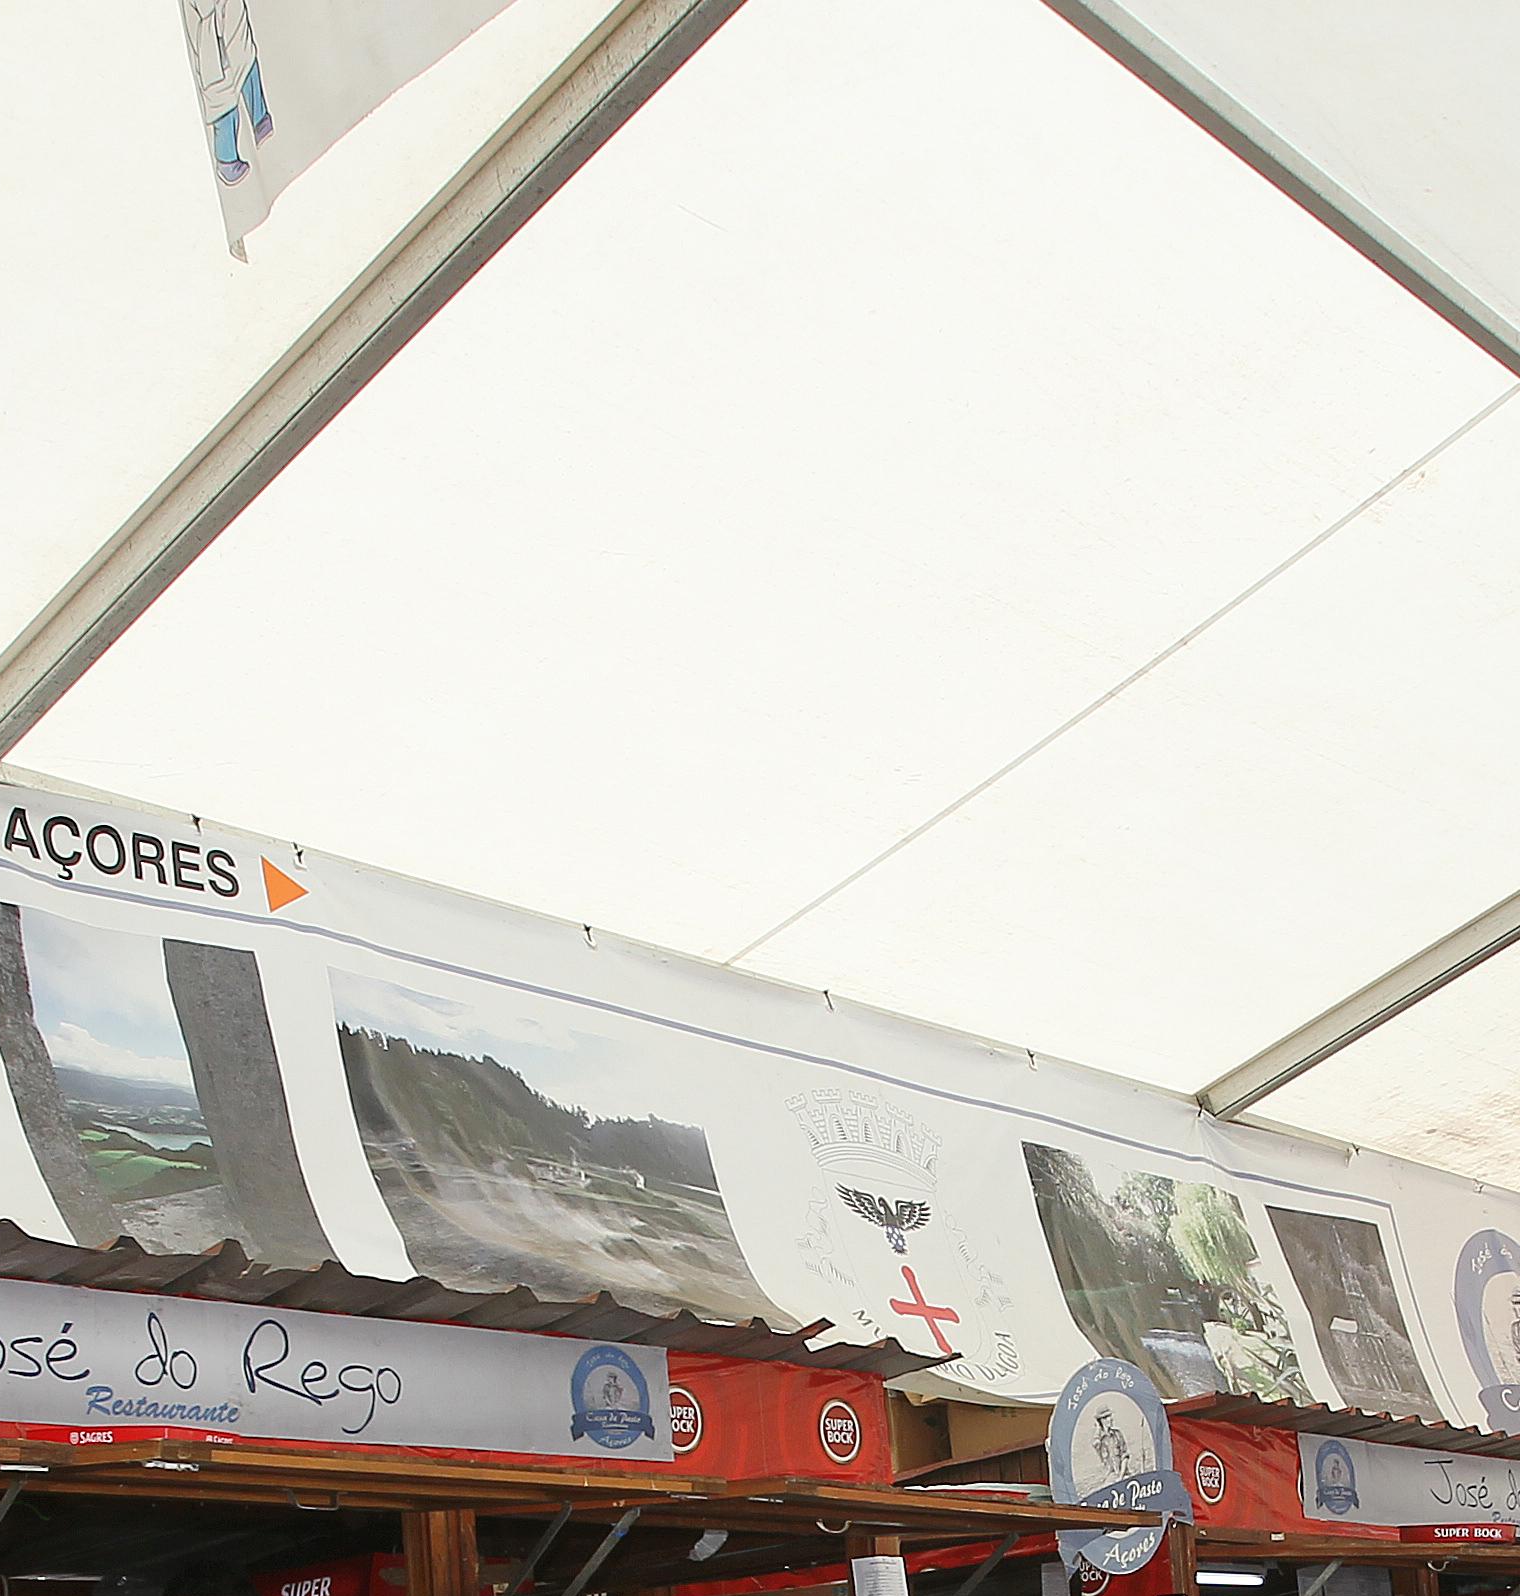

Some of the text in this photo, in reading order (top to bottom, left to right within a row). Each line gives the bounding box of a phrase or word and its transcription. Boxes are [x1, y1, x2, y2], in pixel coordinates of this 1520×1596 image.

[4, 807, 241, 898] AÇORES
[134, 1312, 198, 1390] do
[241, 1318, 403, 1436] Rego
[84, 1384, 241, 1425] Restaurante
[668, 1406, 696, 1421] UPER
[671, 1419, 696, 1434] OCK
[823, 1417, 855, 1433] SUPER
[79, 1430, 113, 1445] SAGRES
[826, 1430, 855, 1446] BOCK
[1110, 1489, 1126, 1509] de
[1126, 1479, 1164, 1505] Pasto
[1423, 1459, 1493, 1509] José
[1433, 1527, 1503, 1539] SUPER BOCK
[1101, 1530, 1156, 1569] Açores
